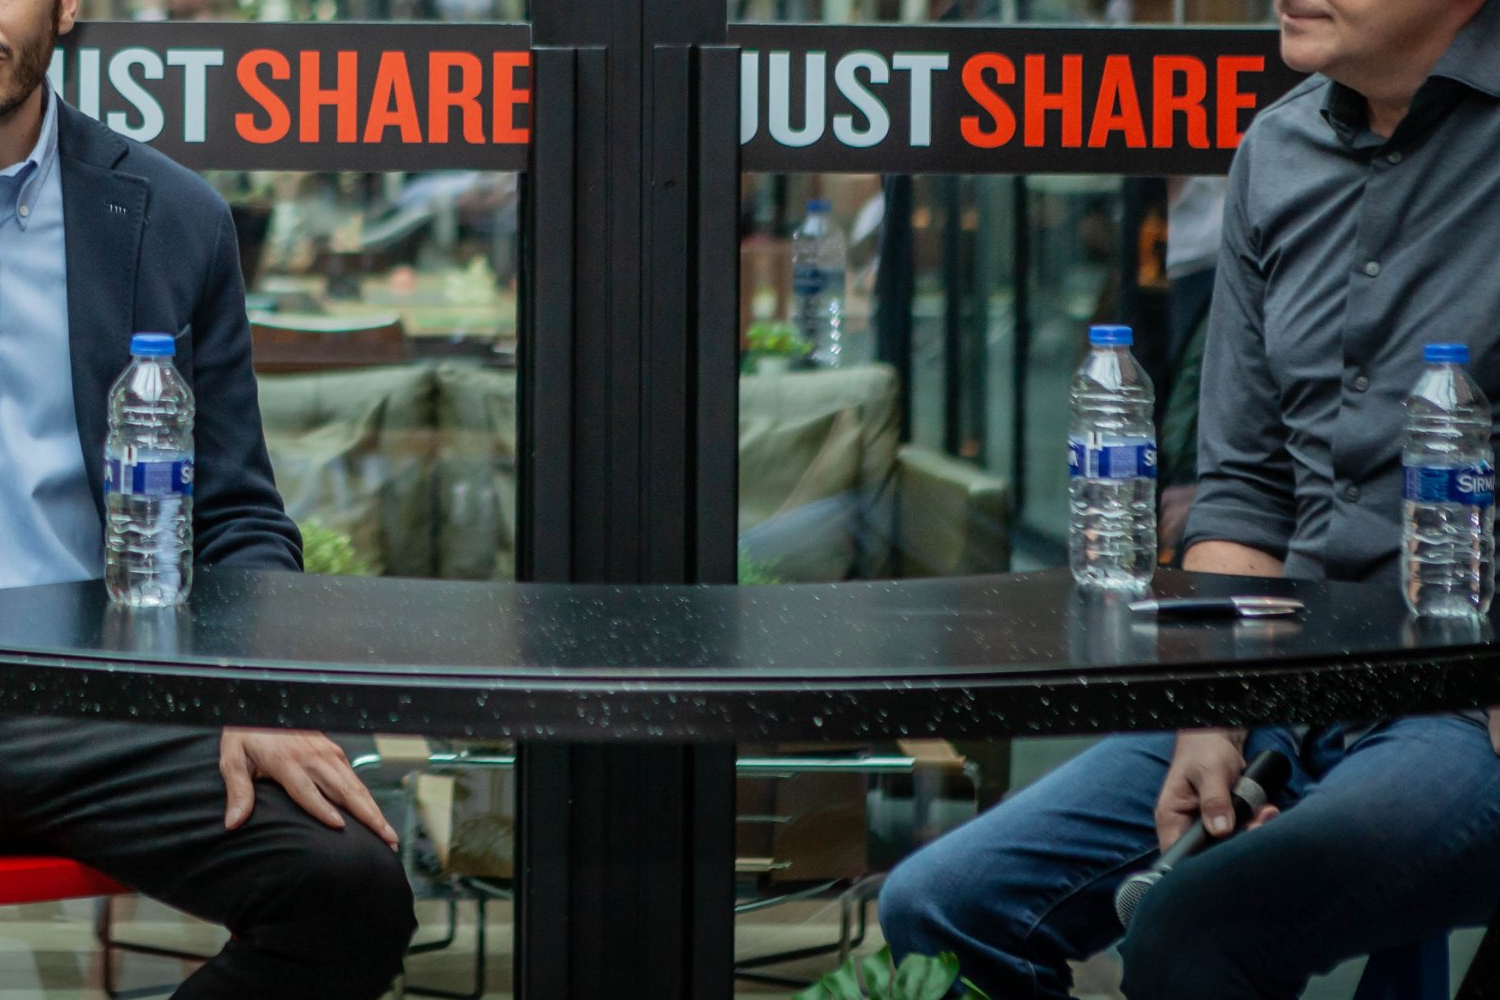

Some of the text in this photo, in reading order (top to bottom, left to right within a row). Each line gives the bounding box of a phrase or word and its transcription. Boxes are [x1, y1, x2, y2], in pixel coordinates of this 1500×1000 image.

[47, 47, 530, 144] UST SHARE
[960, 52, 1266, 149] SHARE
